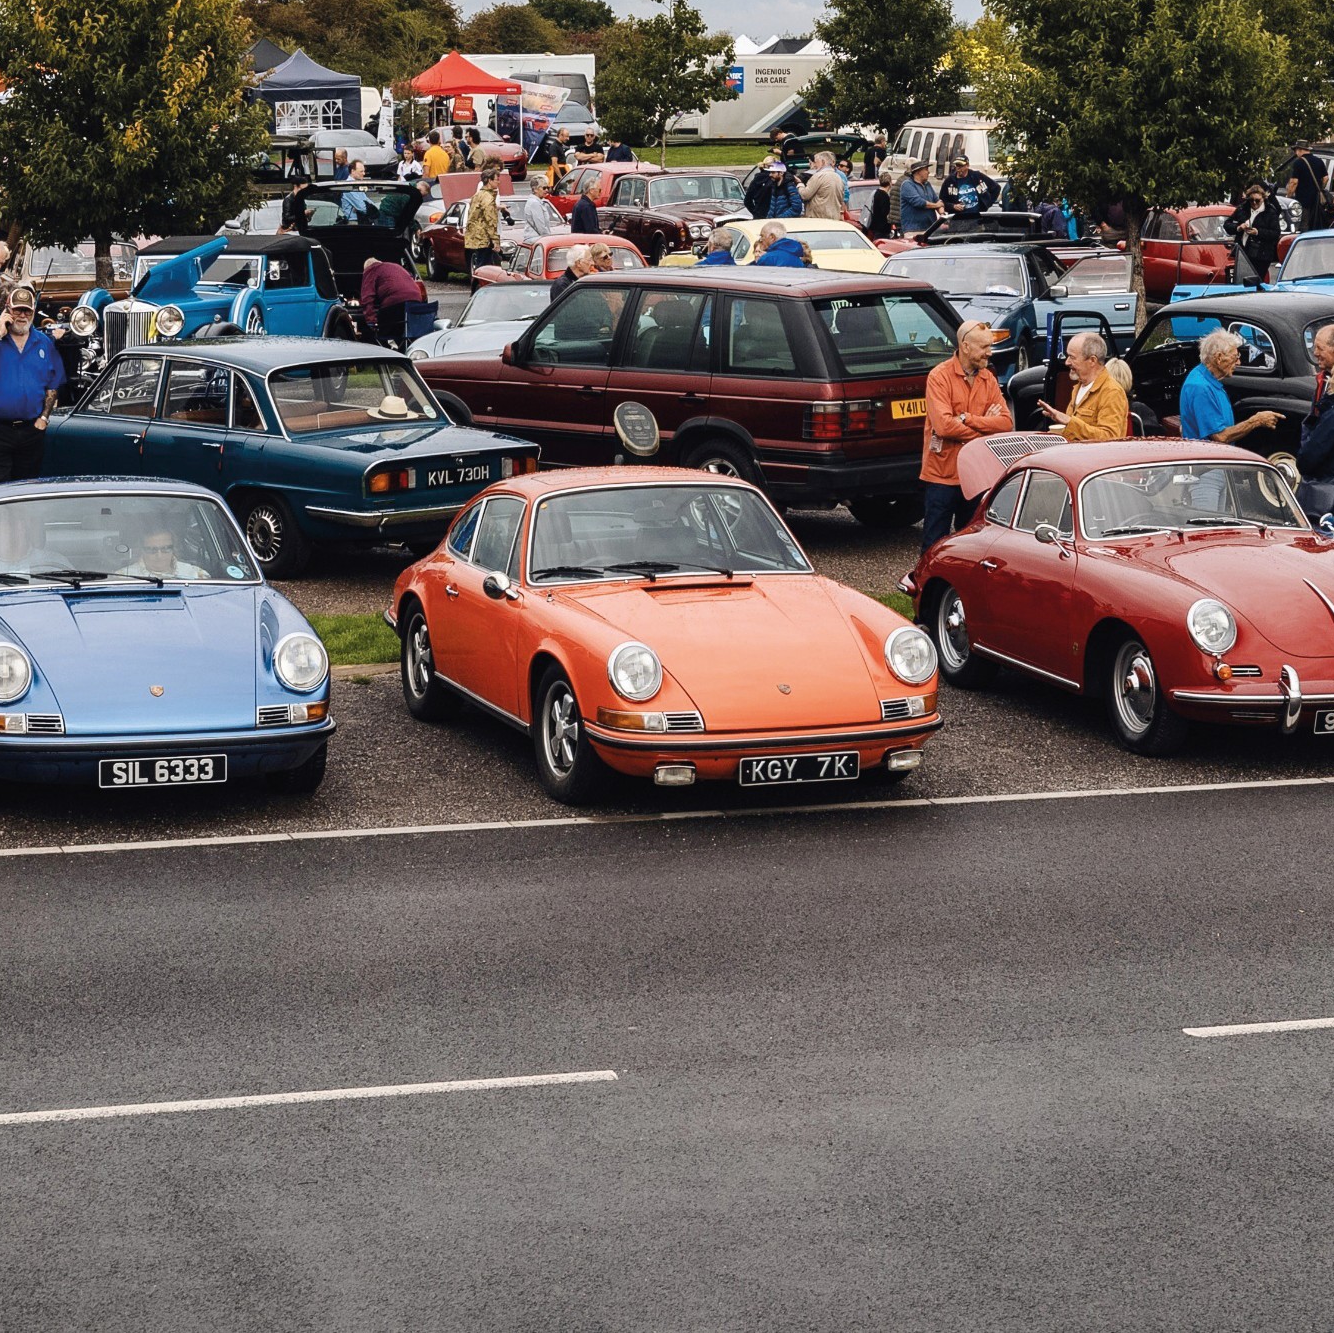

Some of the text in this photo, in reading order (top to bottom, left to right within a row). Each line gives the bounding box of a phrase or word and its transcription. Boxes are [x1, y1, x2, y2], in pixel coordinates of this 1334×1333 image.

[899, 401, 919, 416] Y411
[428, 466, 490, 486] KVL 730H
[112, 758, 214, 785] SIL 6333
[751, 755, 849, 782] KGY 7K
